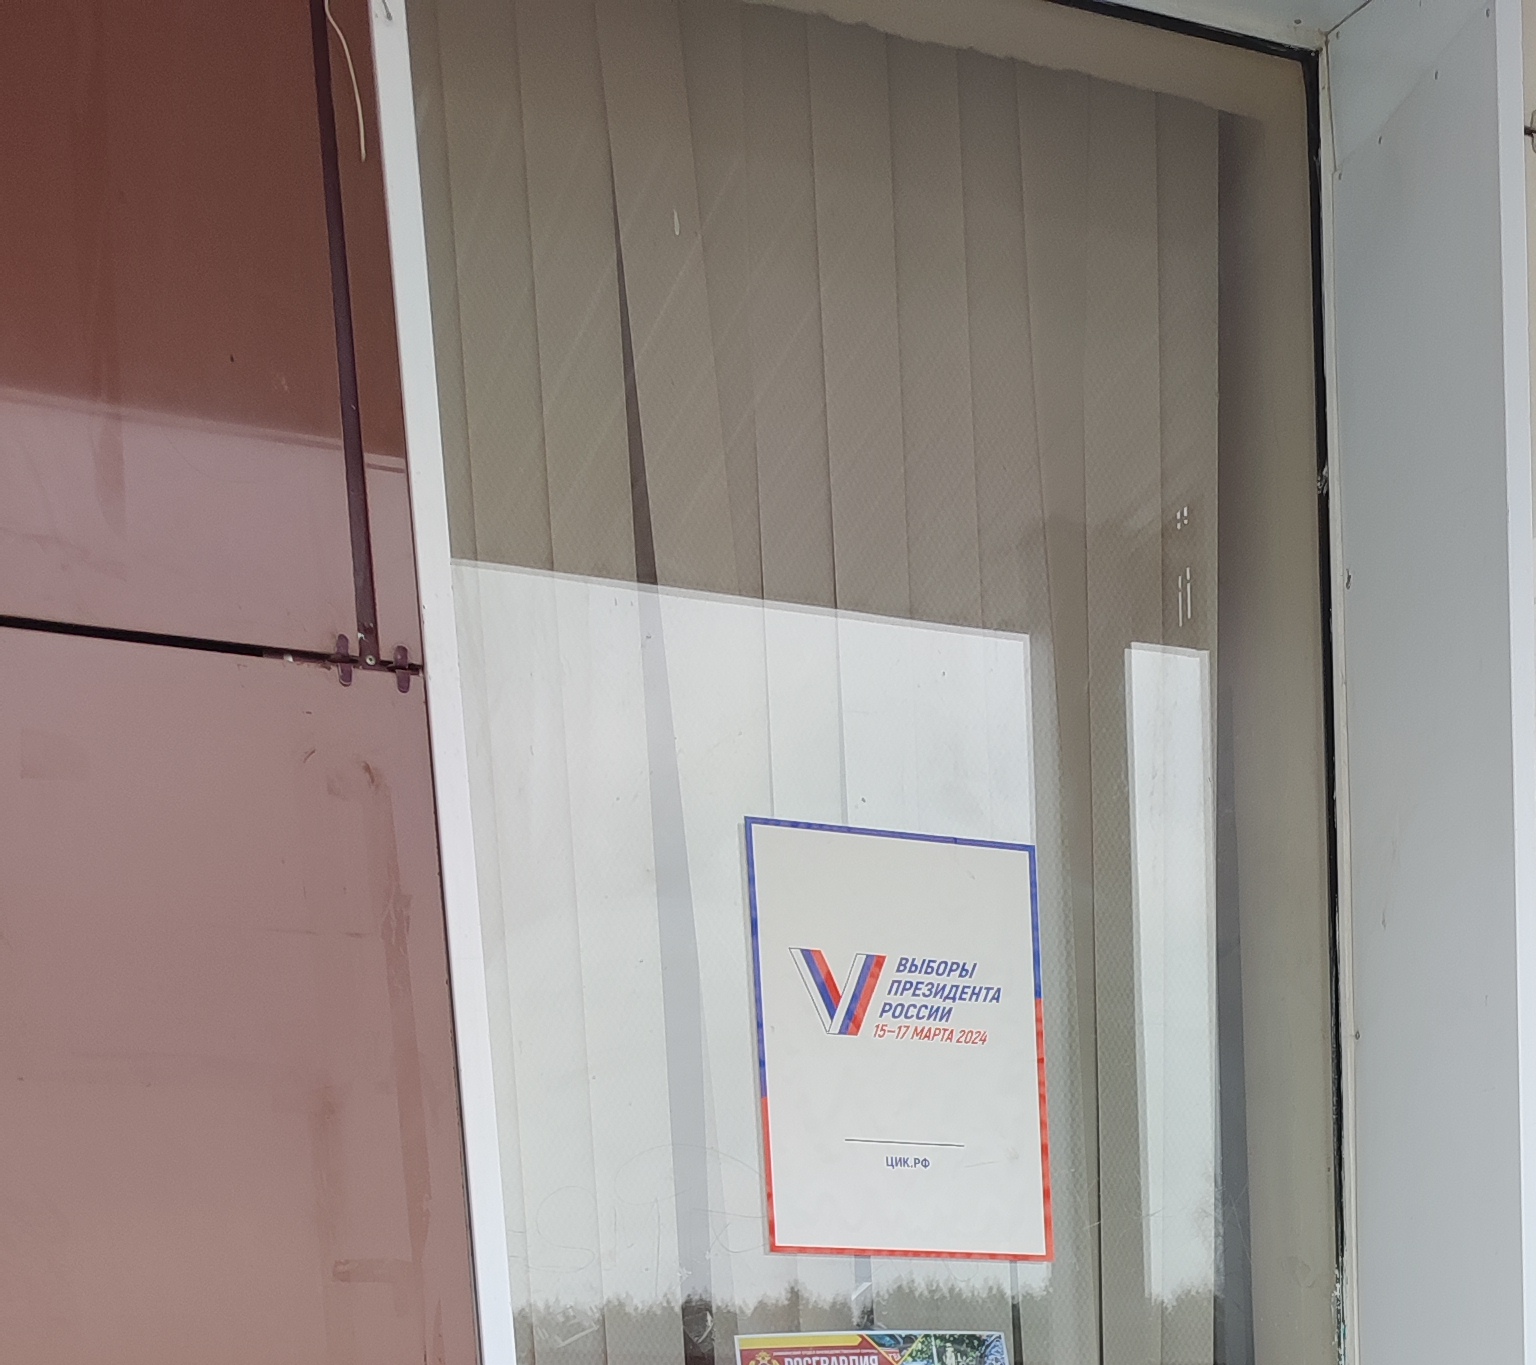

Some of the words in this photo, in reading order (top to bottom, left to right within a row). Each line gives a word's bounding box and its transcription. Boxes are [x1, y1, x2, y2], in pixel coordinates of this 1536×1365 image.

[895, 957, 978, 979] ВЫБОРЫ
[886, 979, 1002, 1003] ПРЕЗИДЕНТА
[878, 1002, 953, 1023] РОССИИ
[910, 1025, 955, 1043] МАРТА
[956, 1029, 988, 1045] 2024
[885, 1156, 931, 1170] ЦИК.РФ
